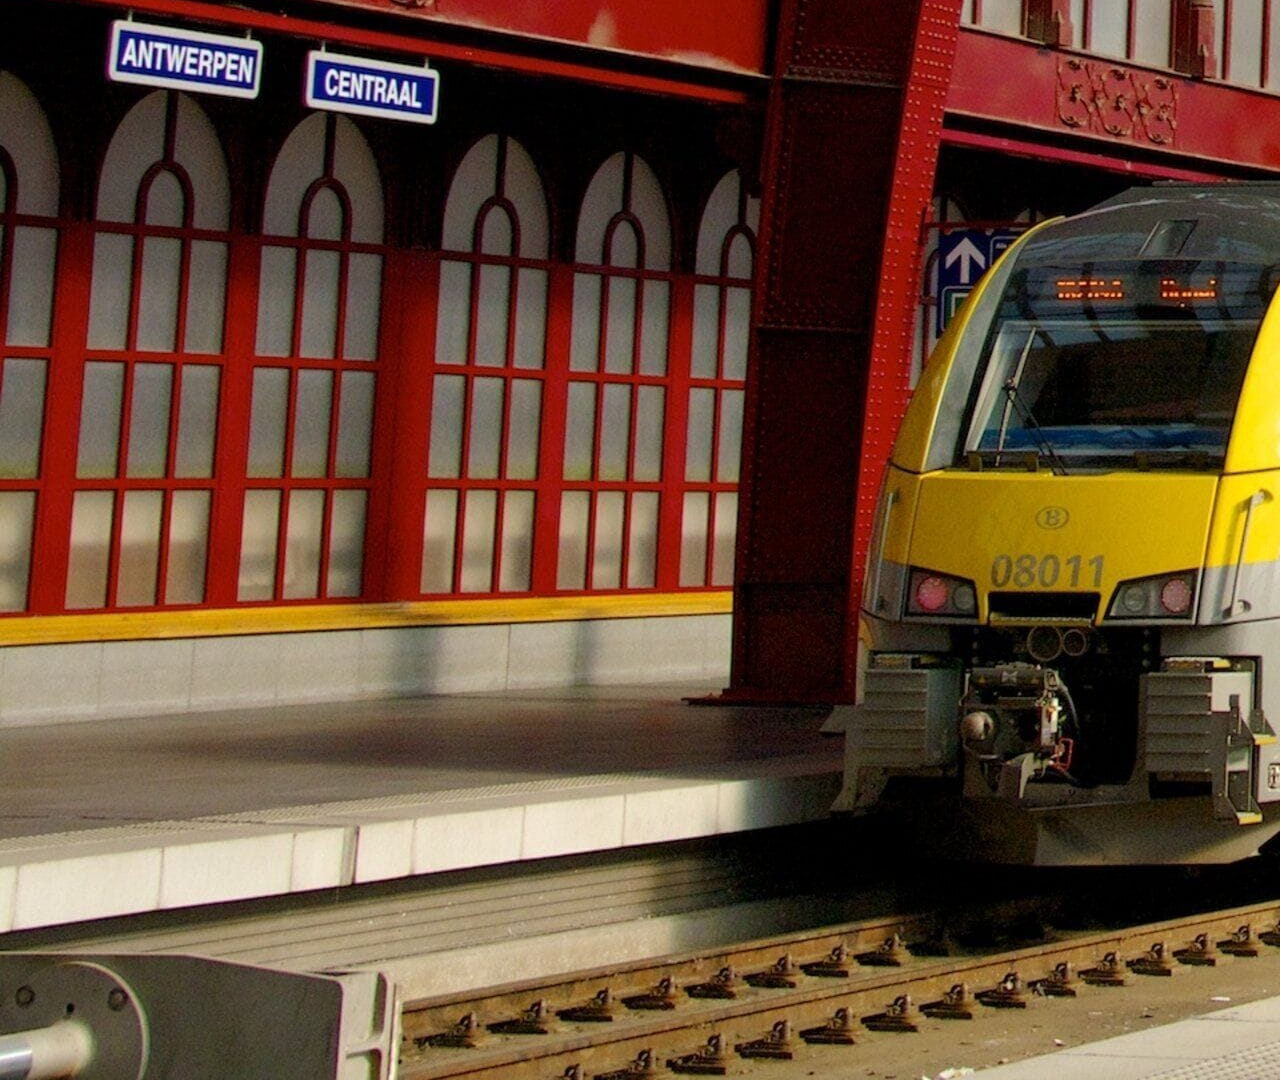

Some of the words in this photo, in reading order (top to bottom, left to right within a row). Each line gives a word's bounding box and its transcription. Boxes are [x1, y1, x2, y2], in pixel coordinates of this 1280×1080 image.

[121, 38, 255, 84] ANTWERPEN
[324, 68, 422, 108] CENTRAAL
[990, 553, 1105, 588] 08011
